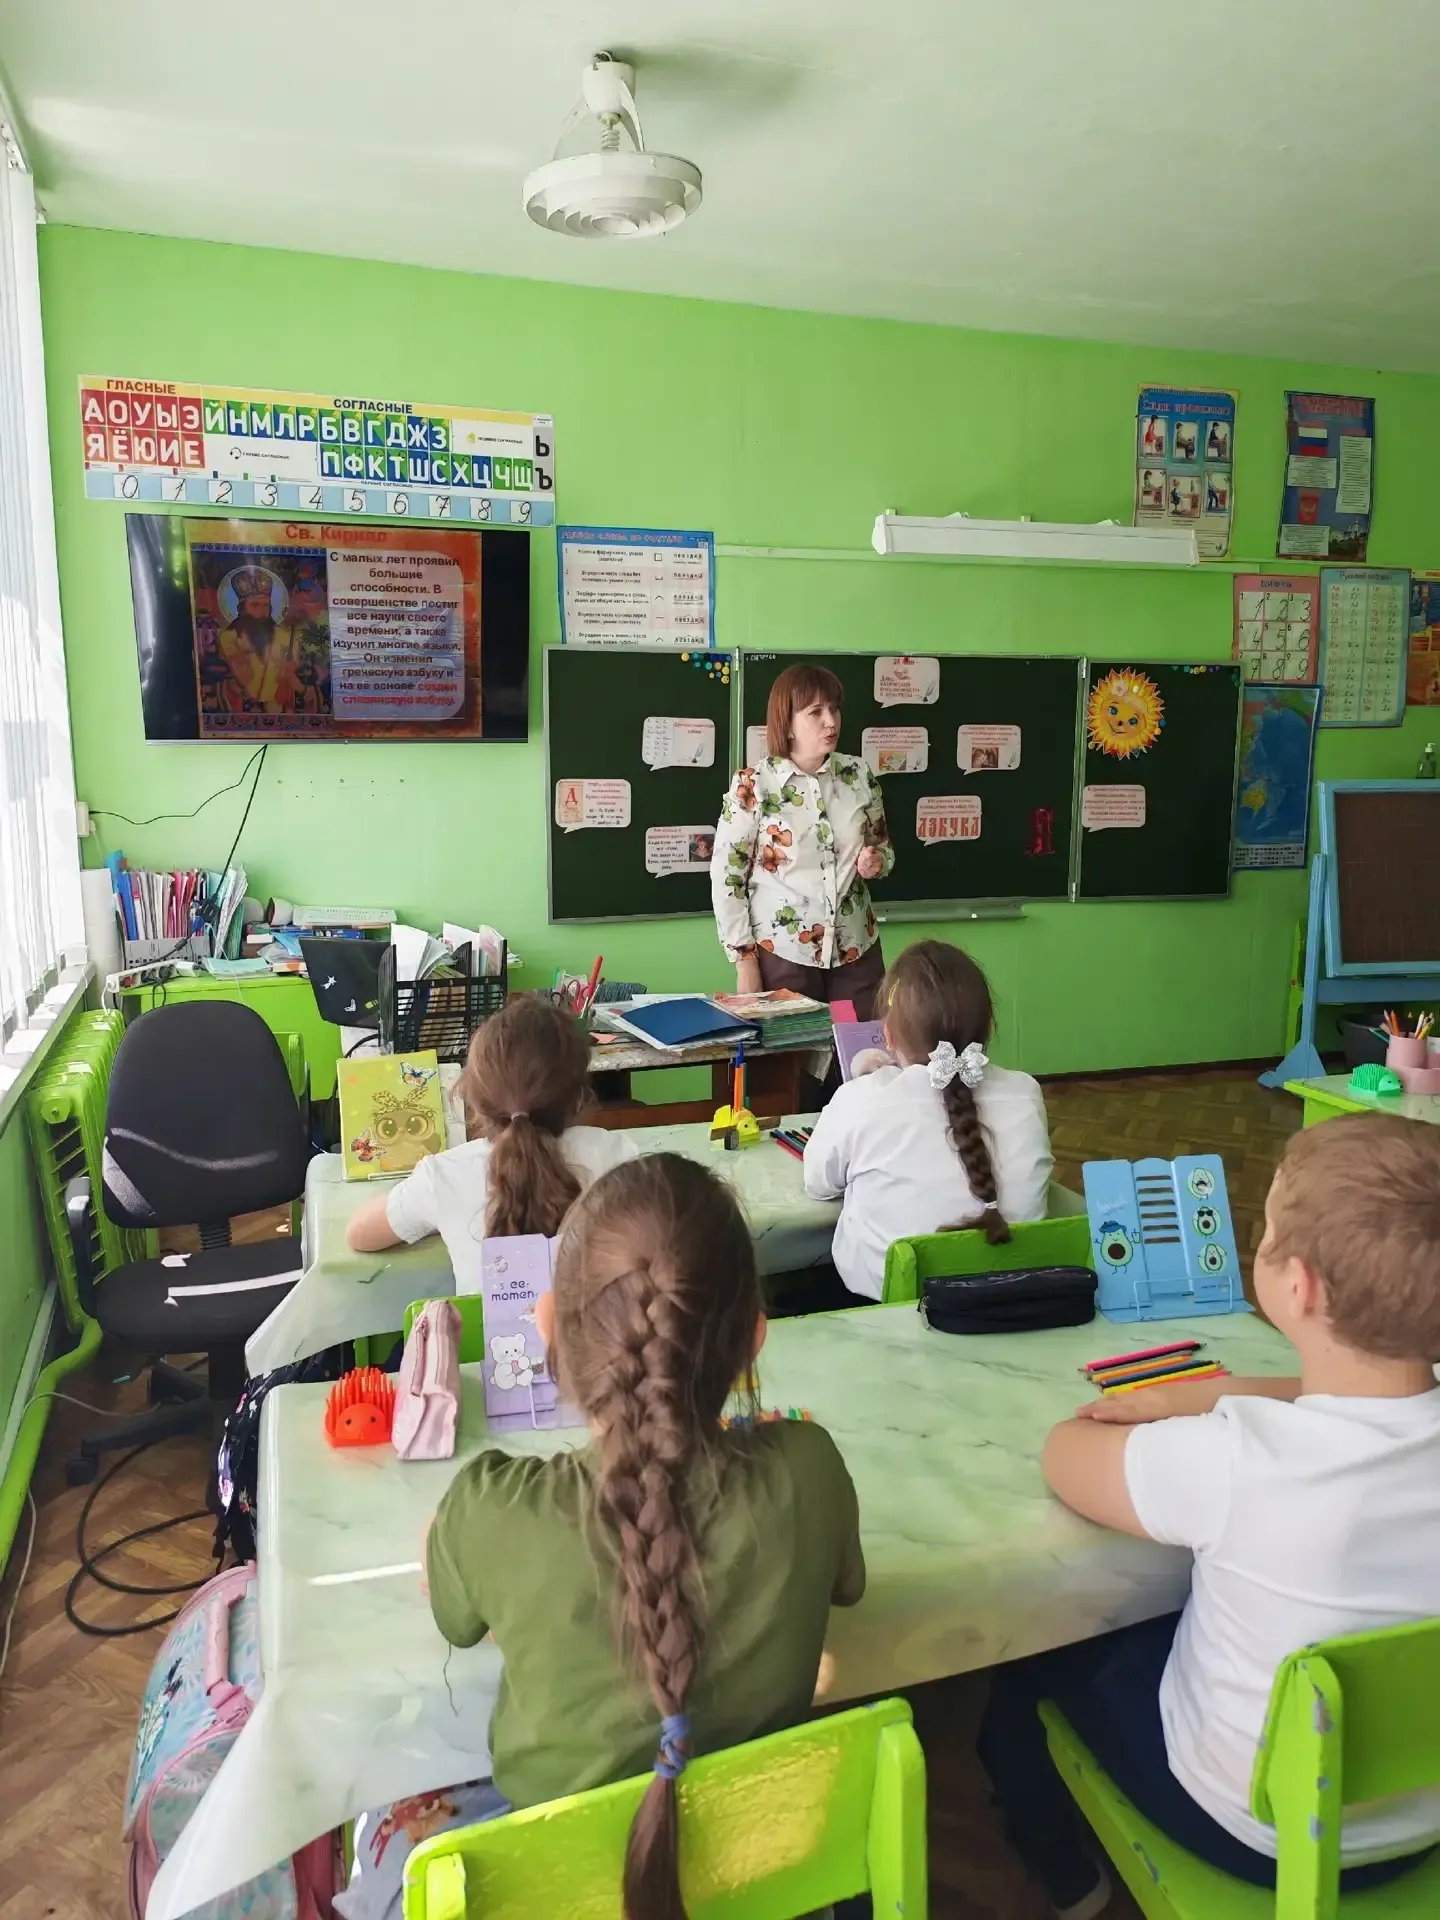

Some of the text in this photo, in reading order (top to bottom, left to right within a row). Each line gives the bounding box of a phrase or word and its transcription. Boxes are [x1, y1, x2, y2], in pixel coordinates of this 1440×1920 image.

[106, 379, 176, 394] ГЛАСНЫЕ
[333, 399, 413, 414] СОГЛАСНЫЕ
[536, 435, 550, 457] Ь
[534, 467, 553, 490] Ъ
[122, 475, 532, 524] 0 1 2 3 4 5 6 7 8 9
[286, 524, 387, 544] Св. Кирилл
[330, 552, 459, 567] С малых лет проявил
[369, 568, 423, 579] большие
[350, 583, 441, 594] способности. В
[332, 598, 459, 609] совершенстве постиг
[1300, 600, 1311, 622] 3
[347, 612, 447, 623] все науки своего
[333, 640, 376, 650] изучил
[378, 641, 420, 649] многие
[1298, 629, 1310, 650] 6
[363, 653, 433, 663] Он изменил
[343, 668, 404, 678] греческую
[407, 668, 443, 678] азбуку
[1273, 658, 1284, 680] 8
[1296, 659, 1308, 680] 9
[374, 682, 414, 690] основе
[417, 682, 457, 691] создал
[342, 695, 413, 706] славянскую
[918, 816, 980, 838] АЗБУКА
